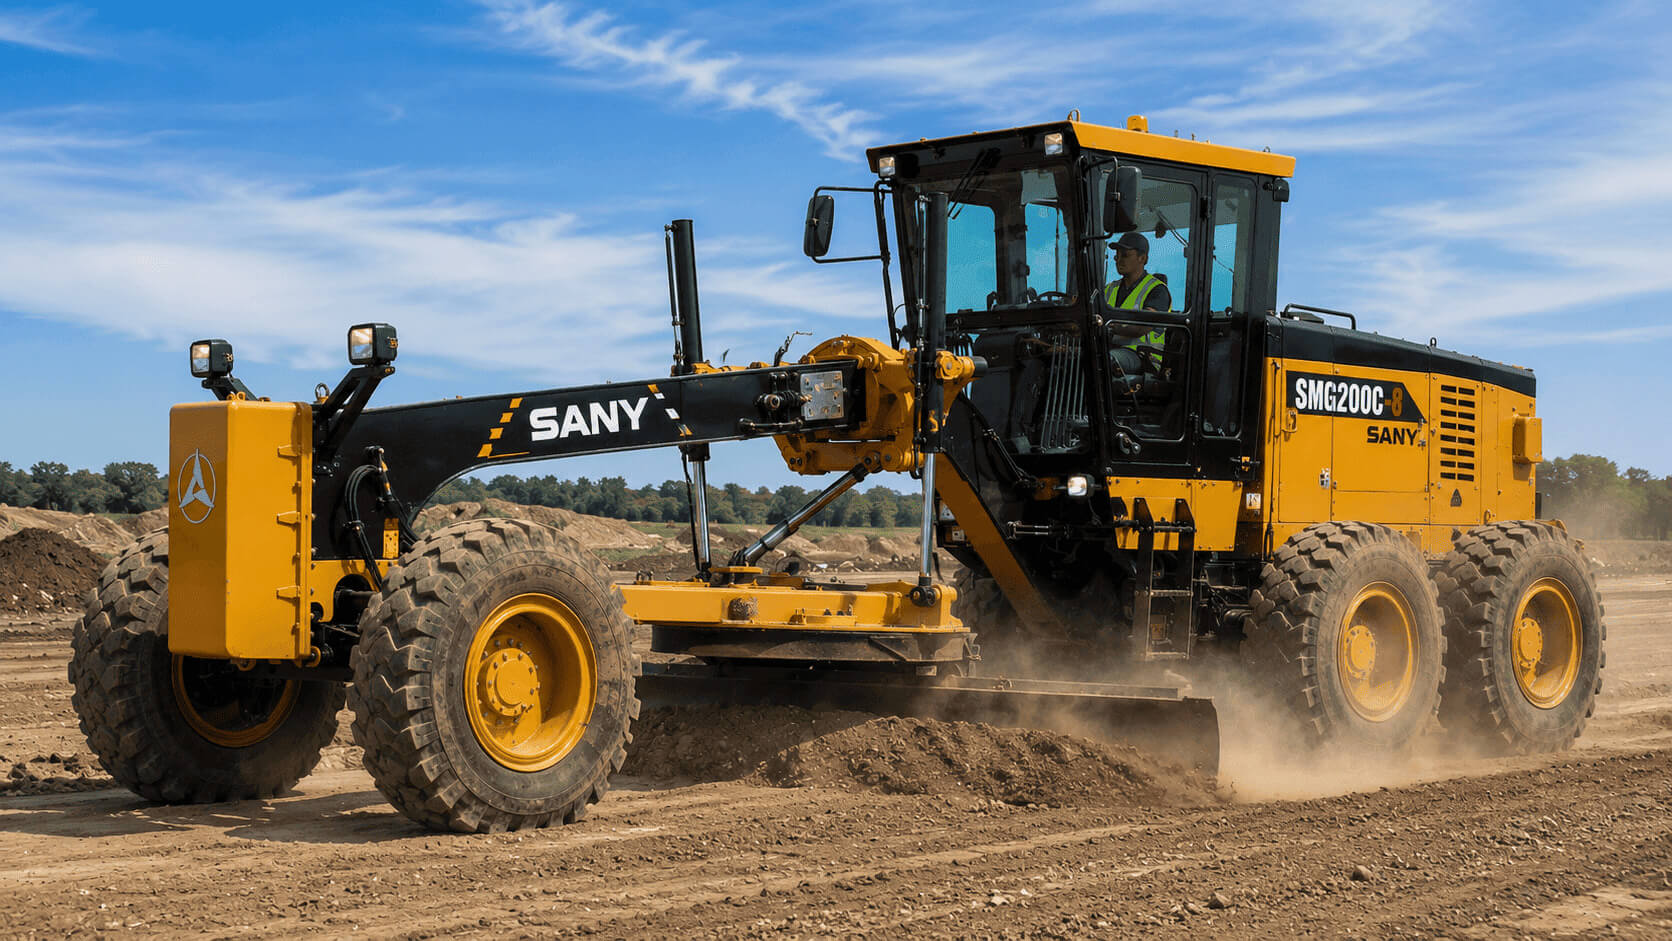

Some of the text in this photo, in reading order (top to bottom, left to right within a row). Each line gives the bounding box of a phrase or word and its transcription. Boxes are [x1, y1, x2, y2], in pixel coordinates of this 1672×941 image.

[1295, 378, 1403, 416] SMG200C-8
[529, 397, 648, 441] SANY
[1366, 426, 1417, 446] SANY
